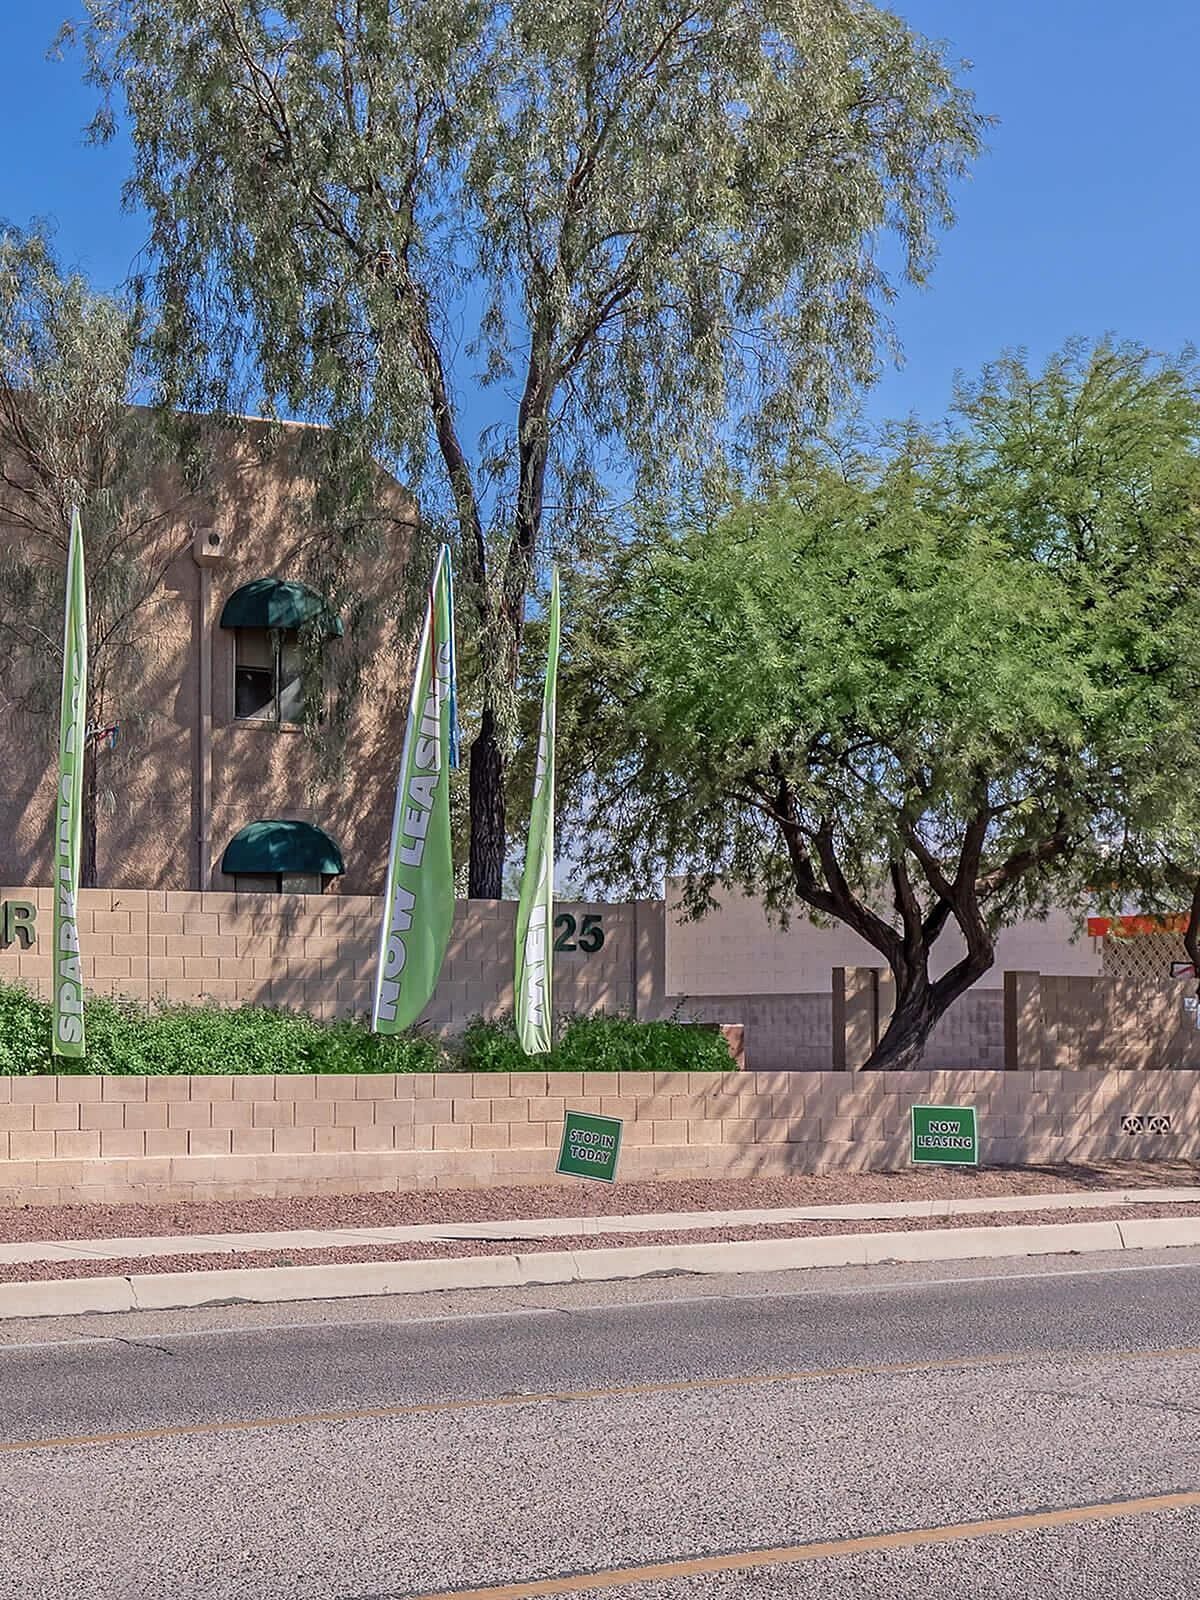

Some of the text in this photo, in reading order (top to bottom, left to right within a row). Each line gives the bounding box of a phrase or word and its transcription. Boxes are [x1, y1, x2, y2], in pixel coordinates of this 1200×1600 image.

[377, 882, 416, 1022] NOW
[929, 1121, 960, 1134] NOW
[570, 1129, 615, 1149] STOP IN
[917, 1135, 972, 1149] LEASING
[570, 1145, 610, 1164] TODAY
